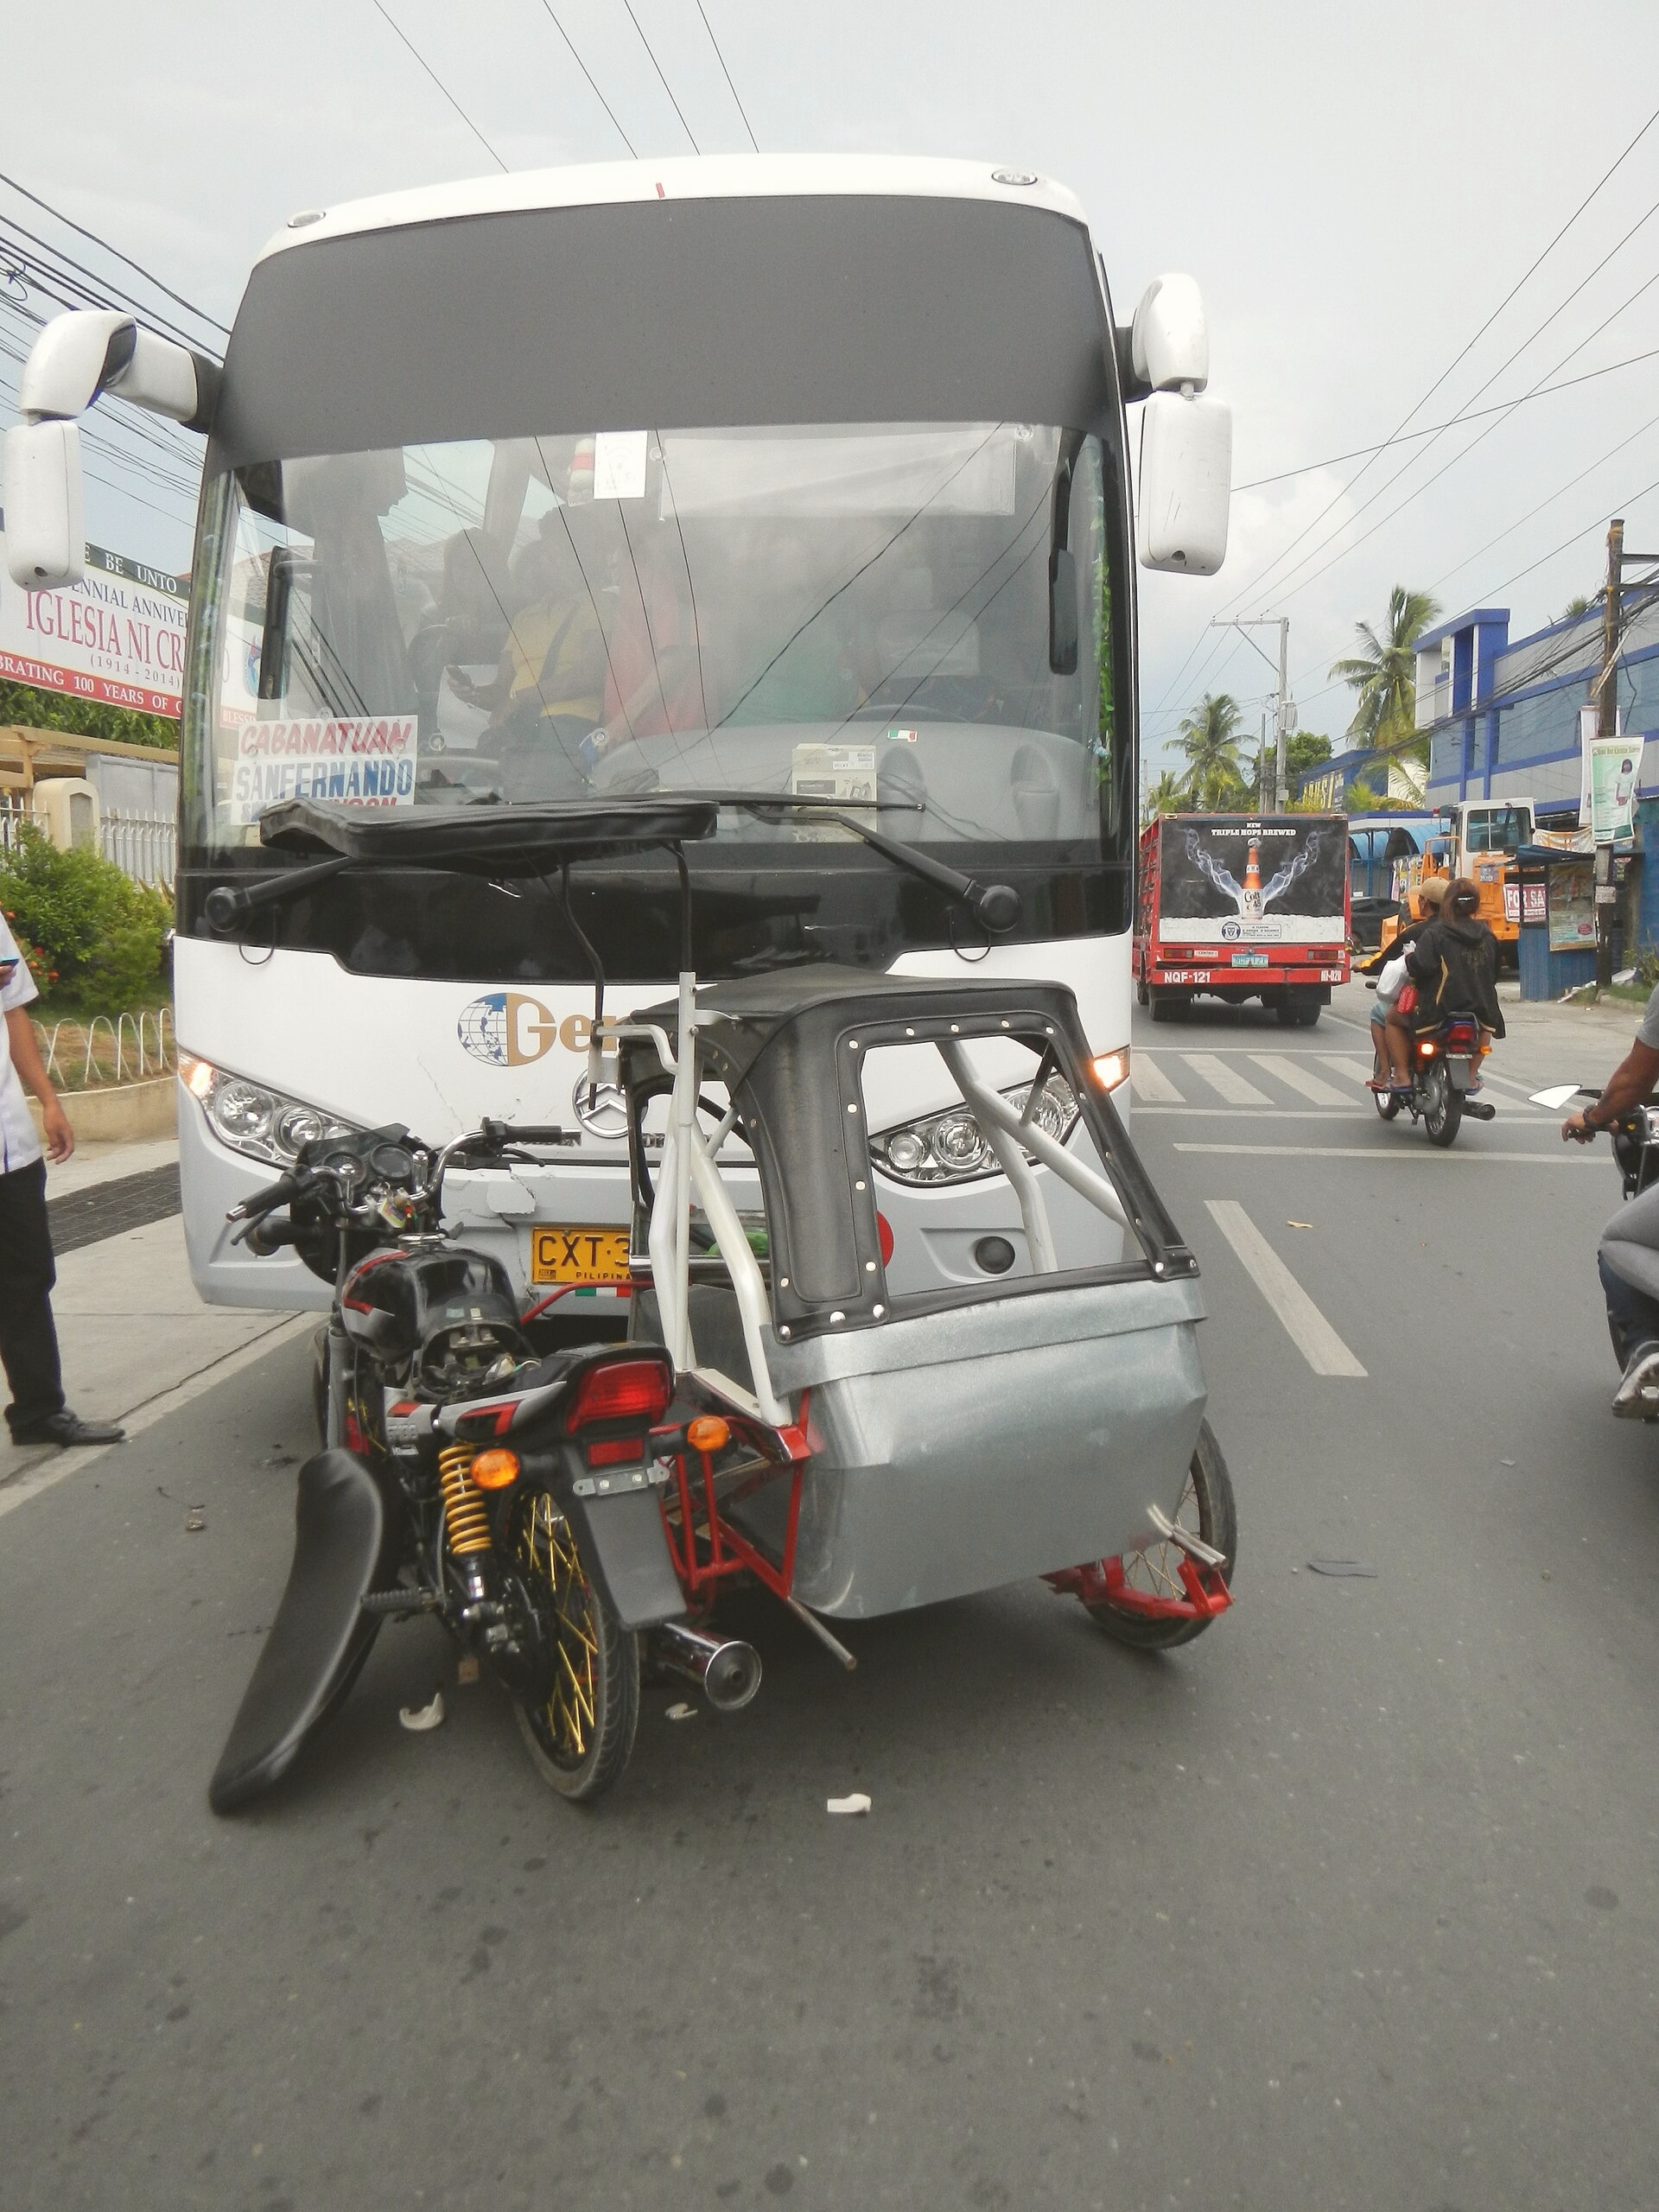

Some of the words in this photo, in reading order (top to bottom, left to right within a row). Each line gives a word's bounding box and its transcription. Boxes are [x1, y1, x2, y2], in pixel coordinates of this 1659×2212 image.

[105, 552, 124, 575] BE
[137, 565, 177, 594] UNTO
[27, 589, 122, 657] IGLESIA
[127, 619, 151, 664] NI
[156, 629, 188, 673] CR
[73, 676, 94, 692] 100
[104, 683, 144, 705] YEARS
[152, 696, 168, 710] OF
[241, 721, 412, 754] CABANATUAN
[1530, 889, 1546, 907] SA
[1164, 971, 1211, 983] NQF-121
